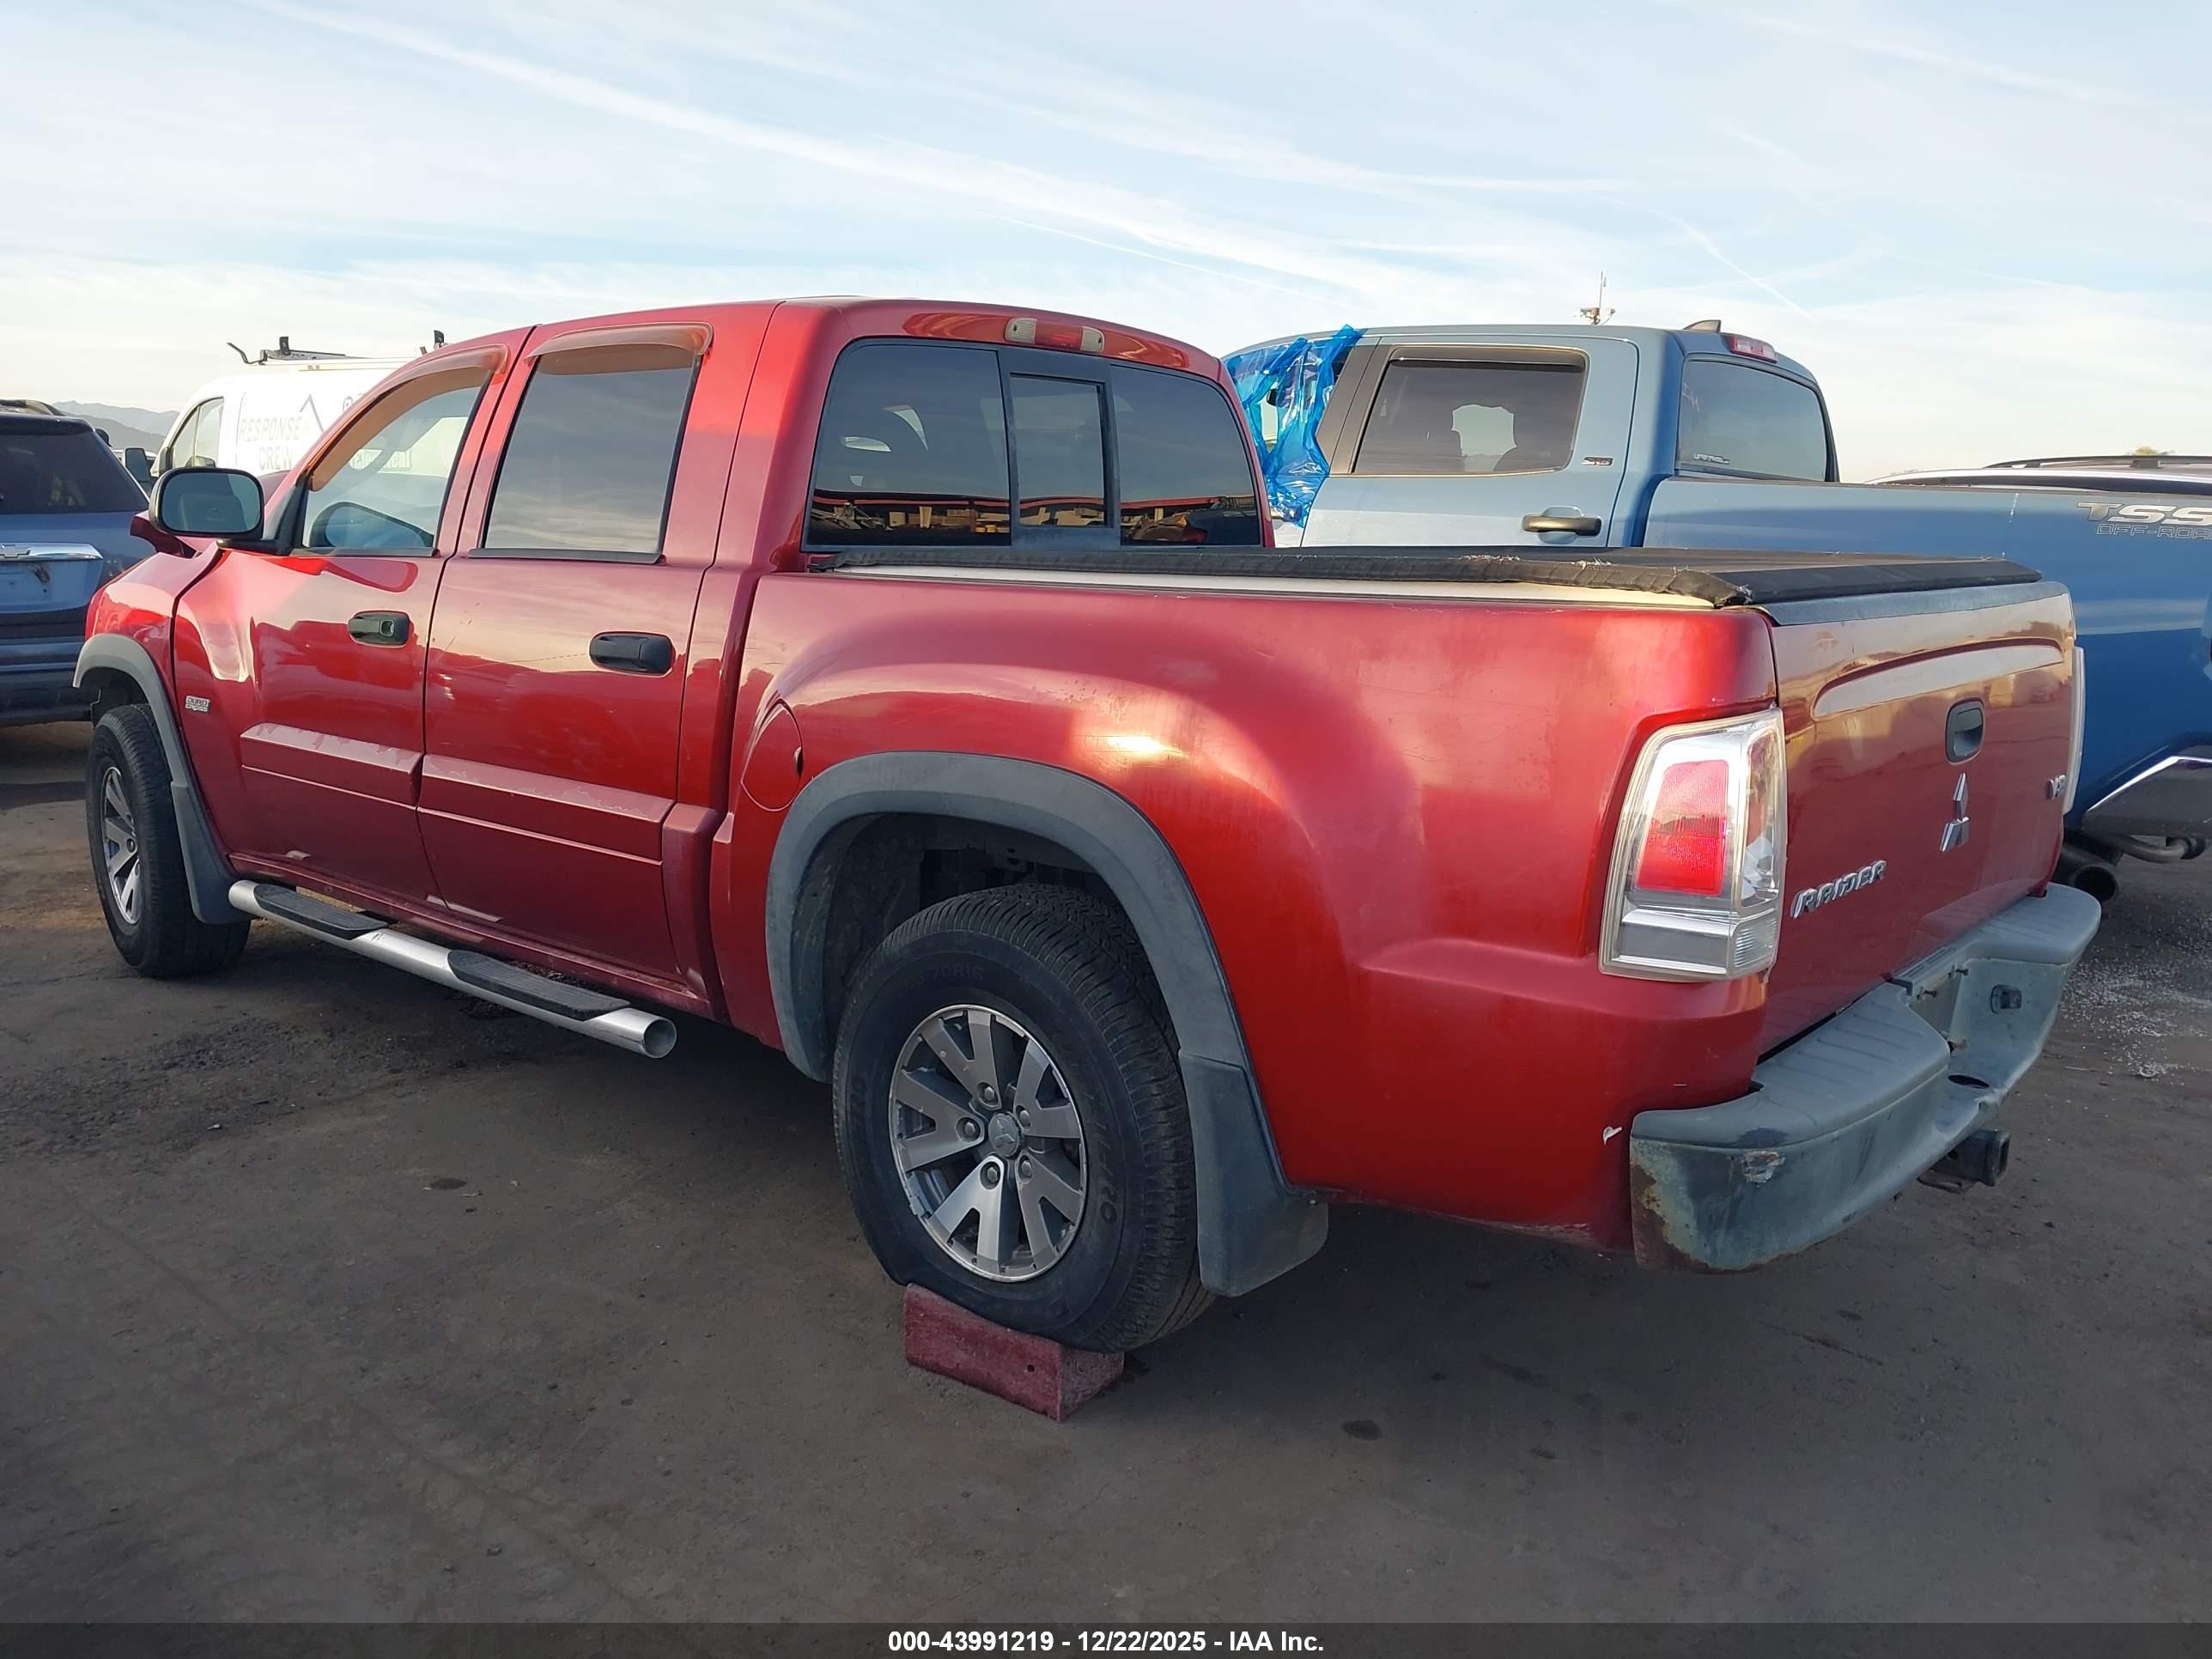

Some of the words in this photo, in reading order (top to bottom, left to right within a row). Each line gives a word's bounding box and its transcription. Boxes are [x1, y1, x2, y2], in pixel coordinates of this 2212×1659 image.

[239, 416, 303, 442] RESPONSE
[258, 446, 294, 471] CREW
[2077, 501, 2212, 526] TSS
[2096, 523, 2212, 539] OFF-ROA
[1790, 860, 1887, 919] RAIDER
